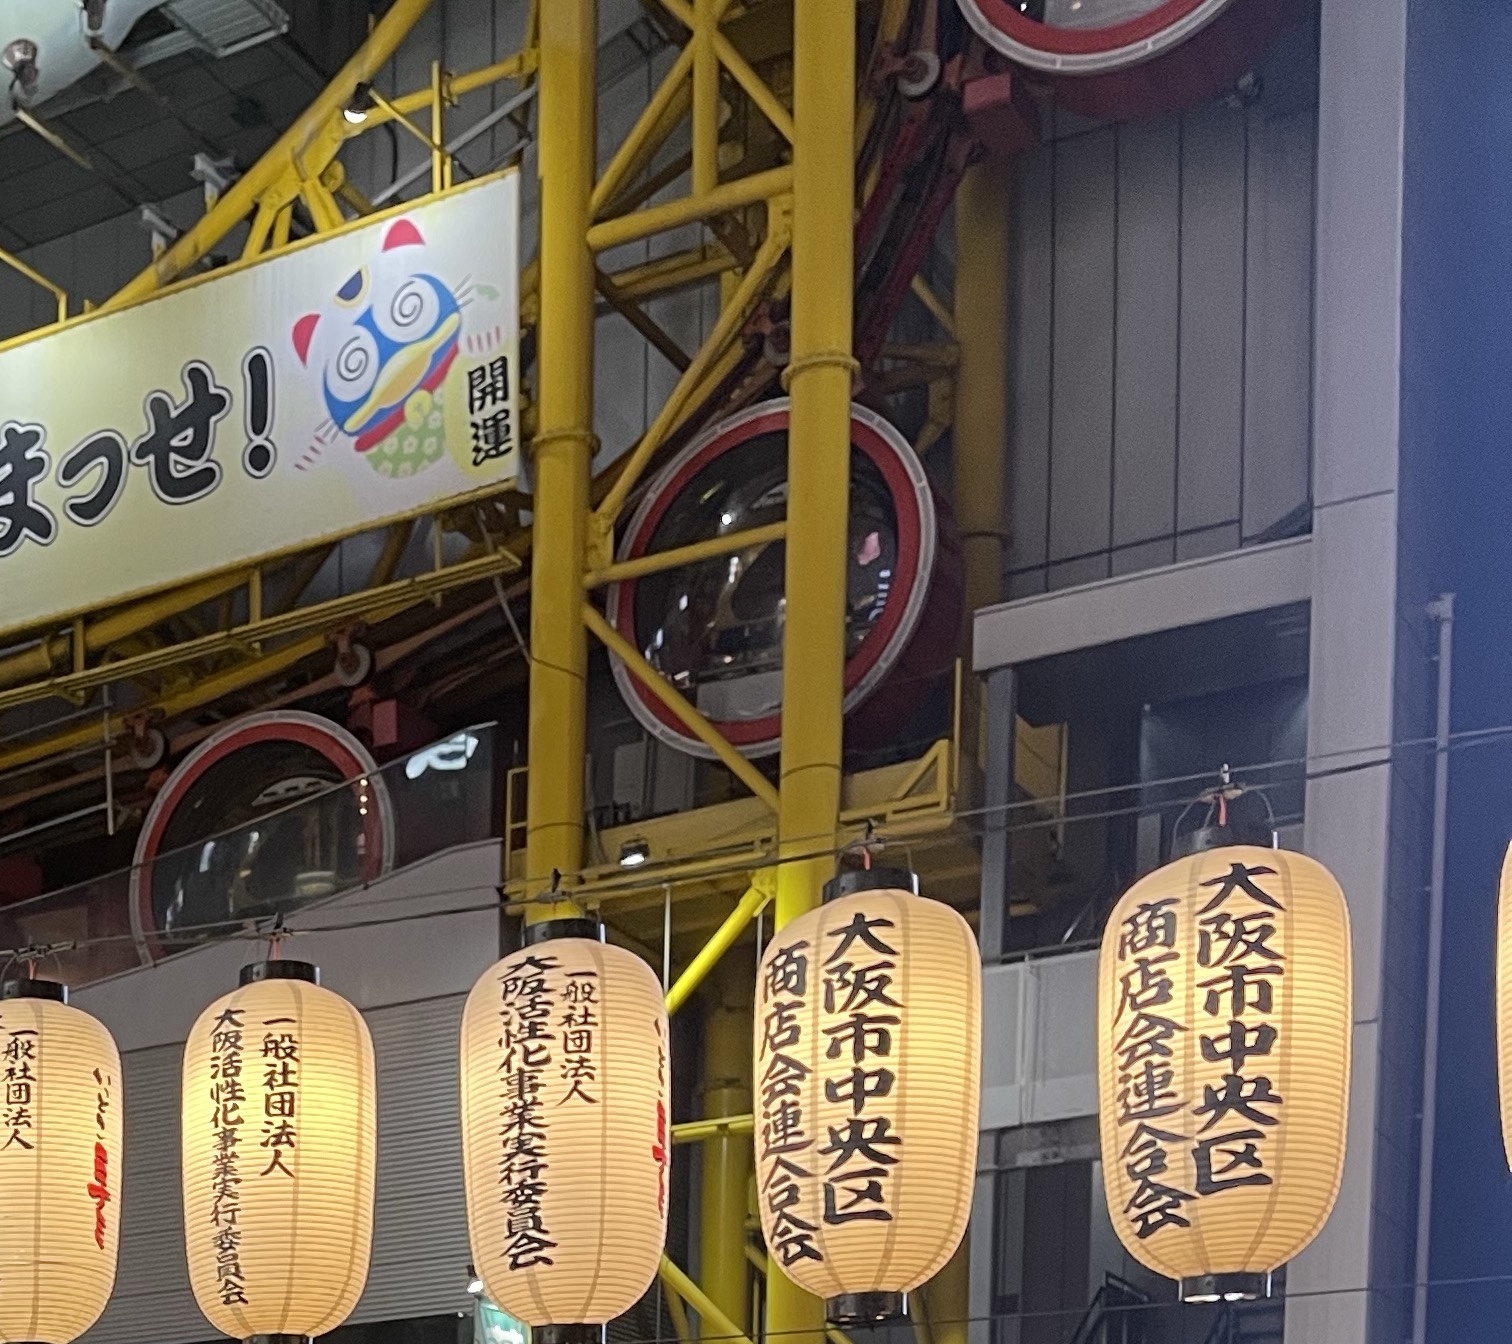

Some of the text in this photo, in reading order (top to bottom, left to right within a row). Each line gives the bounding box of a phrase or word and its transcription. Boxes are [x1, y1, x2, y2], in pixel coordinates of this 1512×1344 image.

[467, 355, 512, 466] 開運
[0, 1027, 37, 1152] 一般社団法人
[210, 1008, 250, 1306] 大阪活性化事業実行委員会
[260, 1018, 299, 1178] 一般社団法人
[498, 955, 559, 1270] 大阪活性化事業実行委員会
[555, 970, 599, 1107] 一般社団法人
[760, 940, 824, 1267] 商店会連合会
[819, 912, 904, 1224] 大阪市中央区
[1115, 898, 1198, 1239] 商店会連合会
[1192, 863, 1286, 1195] 大阪市中央区
